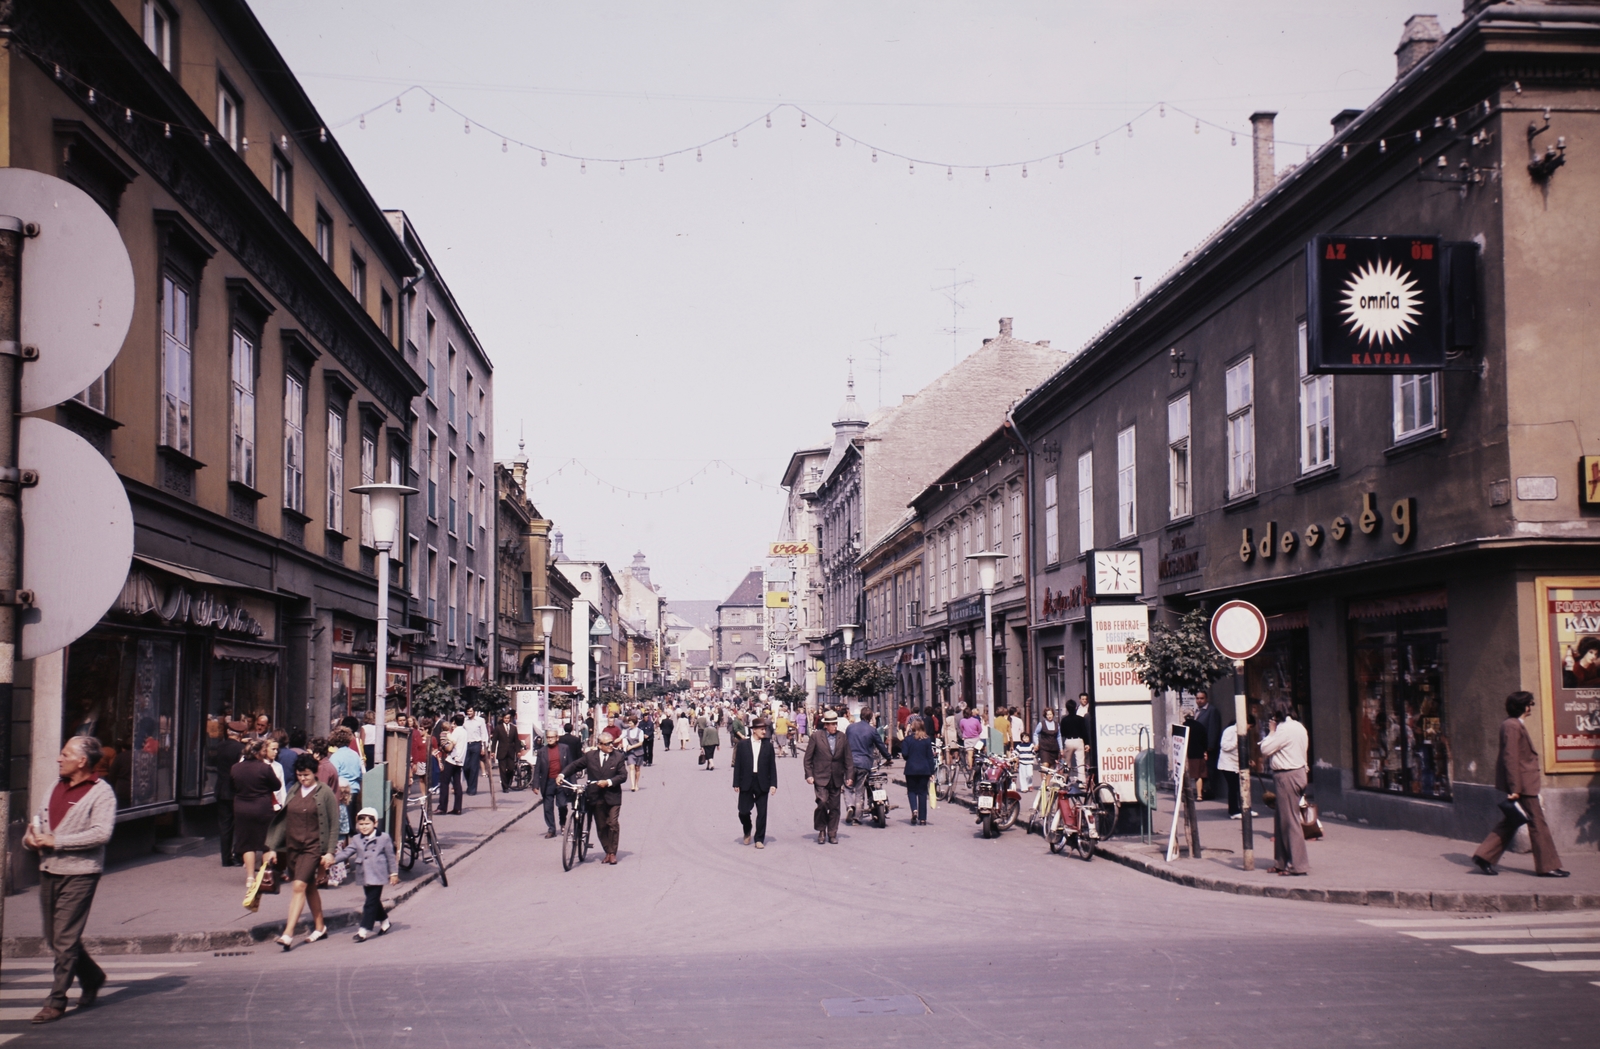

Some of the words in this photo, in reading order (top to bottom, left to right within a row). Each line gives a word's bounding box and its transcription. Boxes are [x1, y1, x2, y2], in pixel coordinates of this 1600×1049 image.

[1325, 243, 1347, 260] AZ
[1411, 241, 1434, 260] ÖN
[1359, 291, 1400, 309] omnia
[1351, 352, 1412, 365] KÁVÉJA
[1239, 492, 1414, 562] édesség
[773, 542, 810, 554] vas
[1555, 601, 1600, 612] FOGYAS
[1095, 619, 1112, 631] TÖBB
[1113, 619, 1140, 631] FEHÉRJE
[1565, 613, 1600, 632] KÁV
[1102, 754, 1135, 771] HÚSIP
[1102, 772, 1134, 783] KÉSZÍTMÉ
